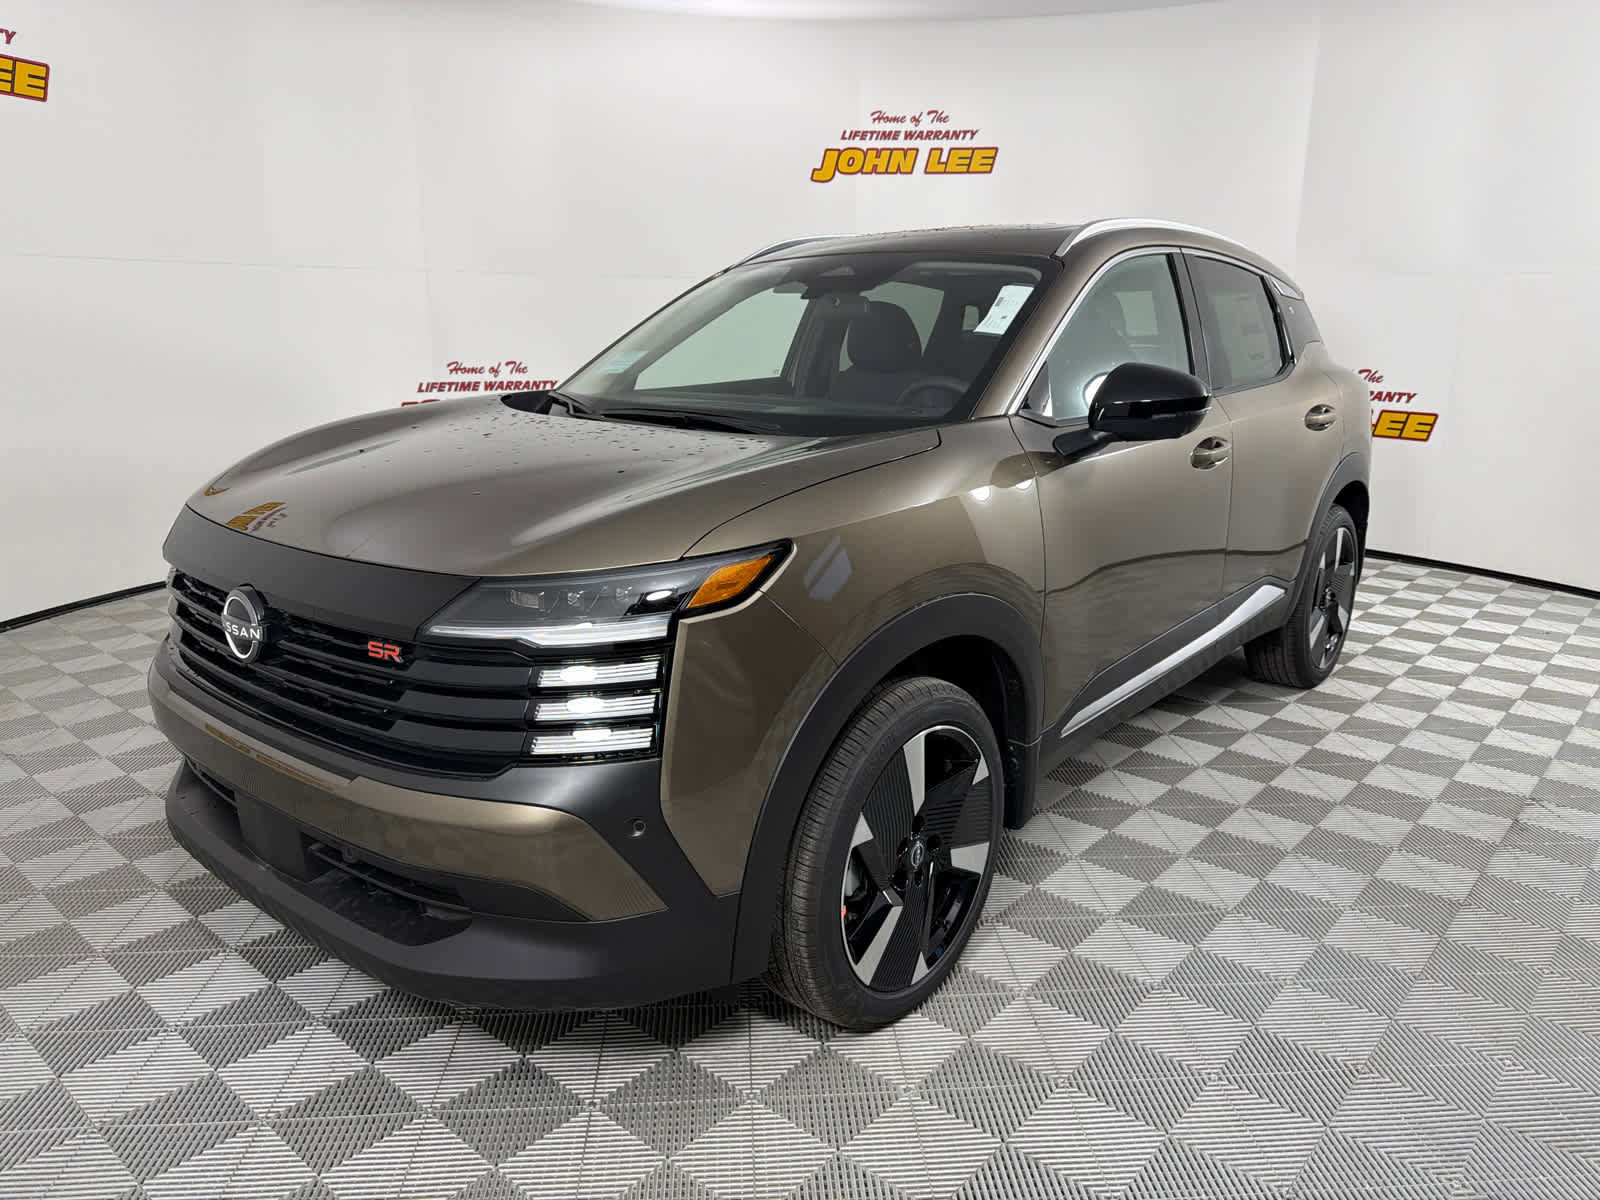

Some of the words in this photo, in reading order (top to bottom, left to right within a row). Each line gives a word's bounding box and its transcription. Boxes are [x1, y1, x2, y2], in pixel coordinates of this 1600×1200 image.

[870, 110, 906, 124] Home
[910, 112, 923, 127] of
[926, 110, 950, 124] The
[840, 130, 901, 141] LIFETIME
[903, 129, 979, 141] WARRANTY
[810, 147, 919, 183] JOHN
[924, 147, 998, 175] LEE
[446, 361, 485, 375] Home
[488, 362, 502, 378] of
[505, 361, 529, 375] The
[1358, 369, 1384, 383] The
[417, 381, 480, 393] LIFETIME
[483, 380, 558, 392] WARRANTY
[1371, 409, 1439, 442] EE
[225, 621, 260, 640] SSAN
[367, 641, 403, 663] SR
